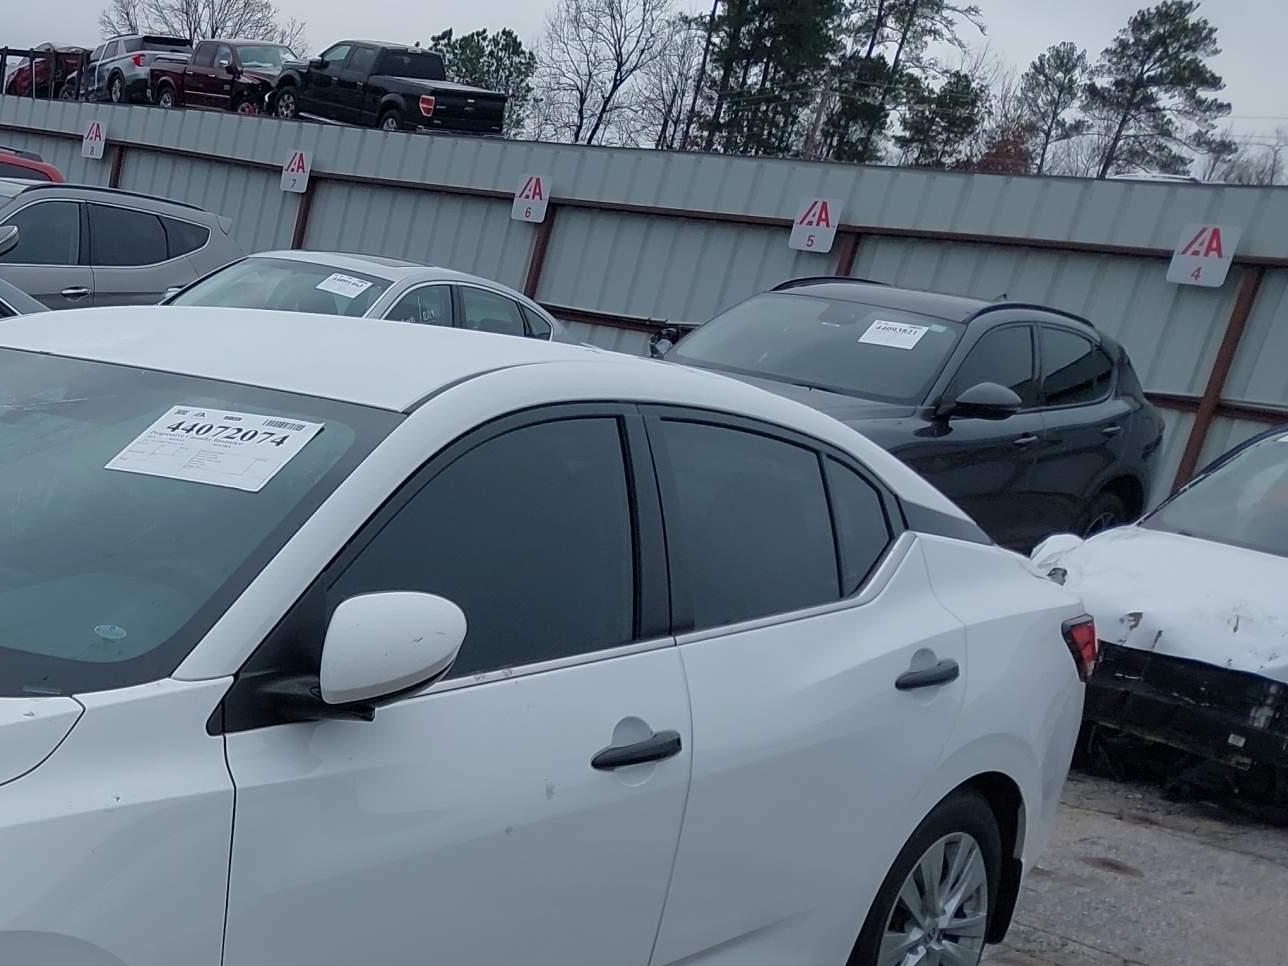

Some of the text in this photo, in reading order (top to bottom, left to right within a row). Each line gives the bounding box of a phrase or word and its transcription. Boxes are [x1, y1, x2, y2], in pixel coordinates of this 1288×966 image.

[524, 206, 532, 218] 6
[806, 234, 816, 248] 5
[1190, 266, 1202, 281] 4
[166, 420, 291, 447] 44072074
